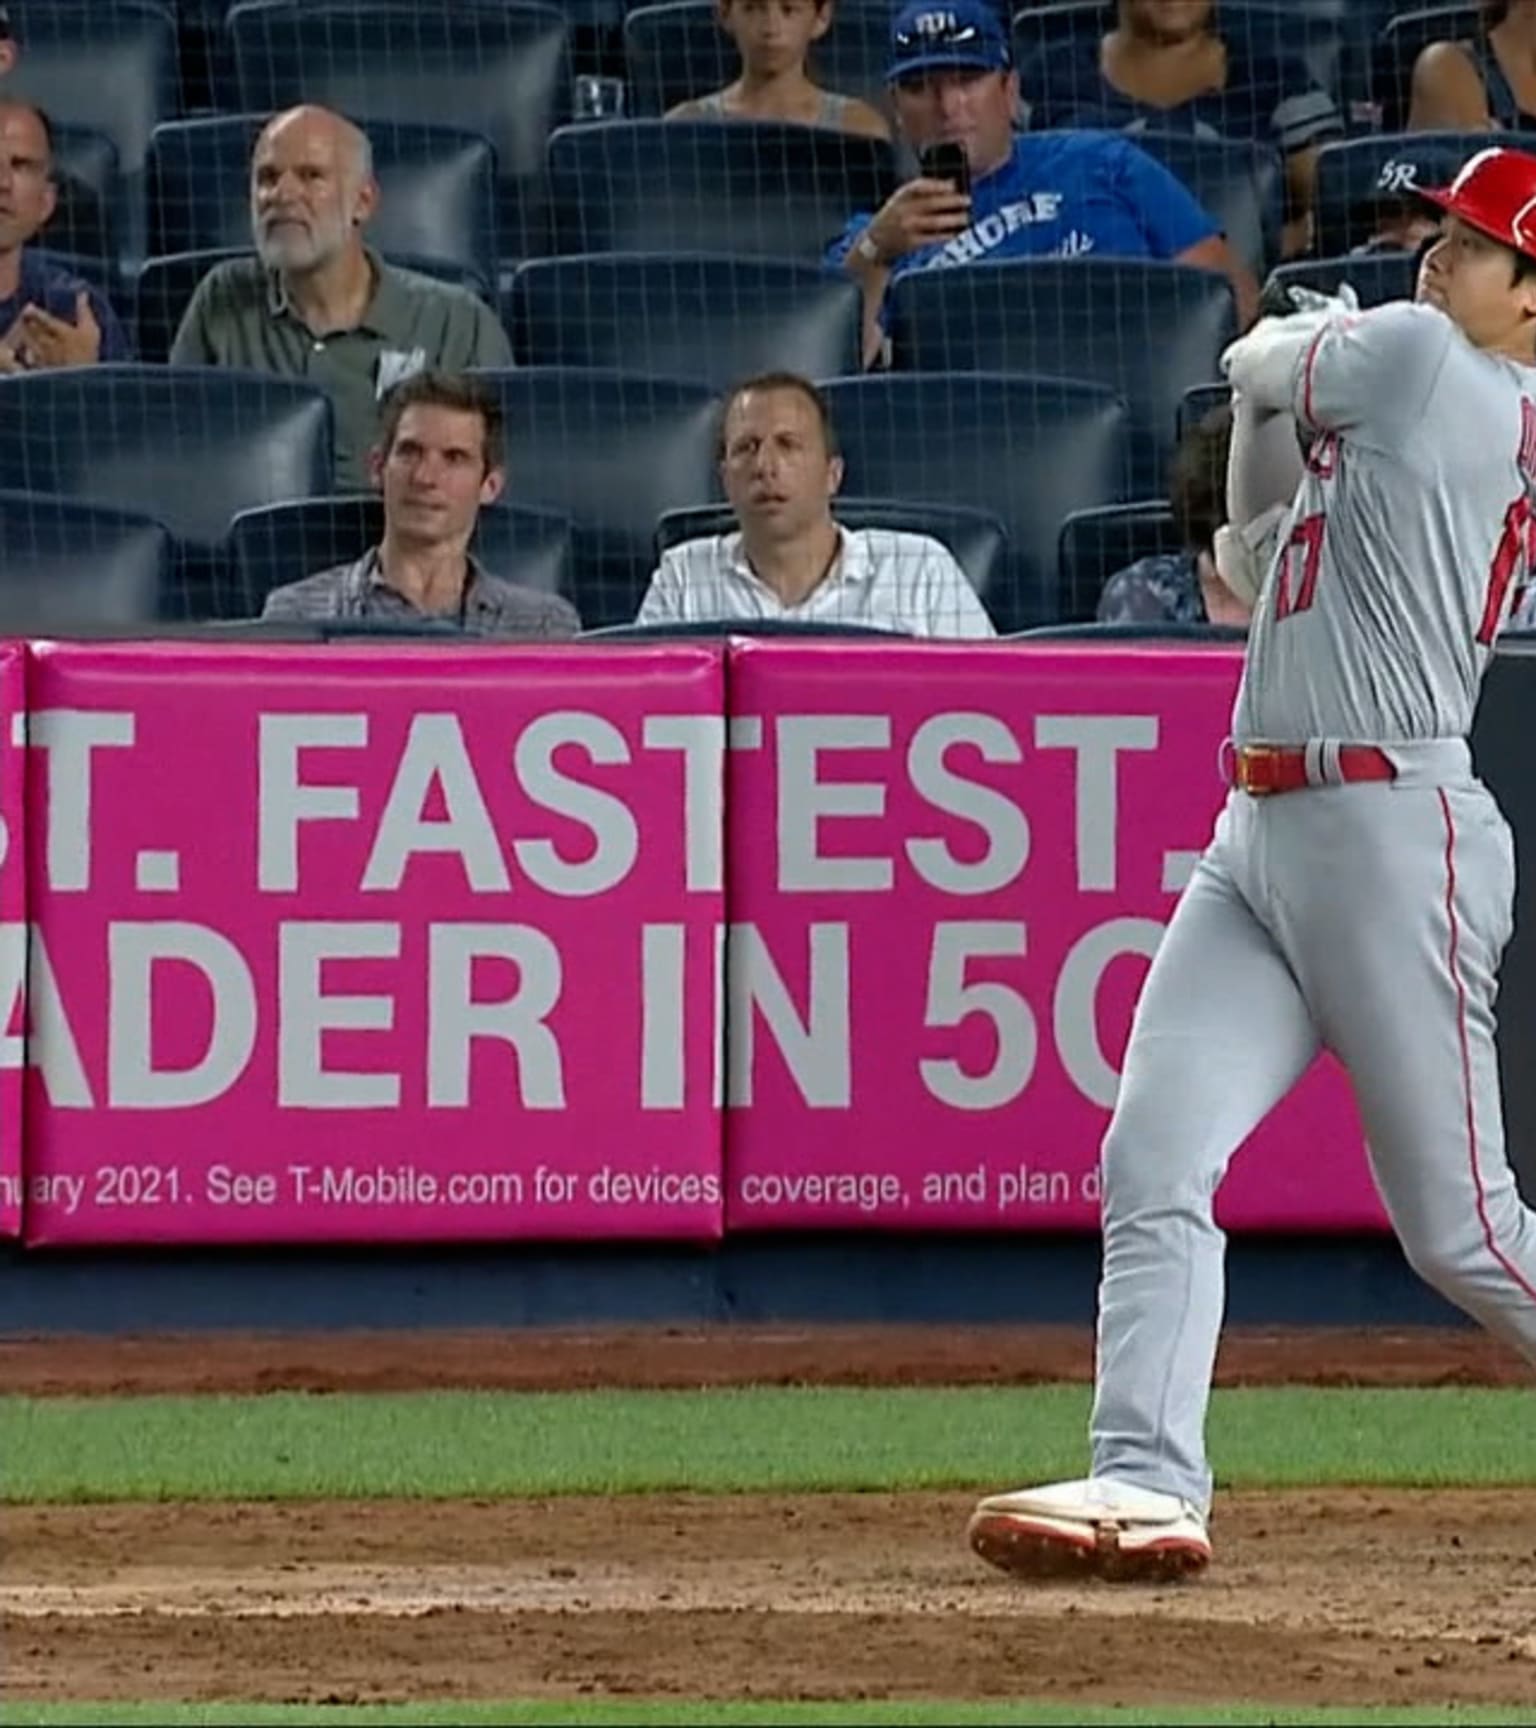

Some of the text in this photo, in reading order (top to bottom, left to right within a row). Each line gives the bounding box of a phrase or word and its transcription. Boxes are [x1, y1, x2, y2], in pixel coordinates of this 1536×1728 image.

[1377, 160, 1421, 192] SR
[0, 711, 1204, 897] T. FASTEST.
[641, 922, 852, 1111] IN
[95, 1164, 194, 1204] 2021.
[206, 1164, 277, 1204] See
[288, 1164, 523, 1204] T-Mobile.com
[534, 1164, 579, 1202] for
[740, 1172, 910, 1212] coverage,
[922, 1163, 987, 1202] and
[998, 1163, 1070, 1210] plan
